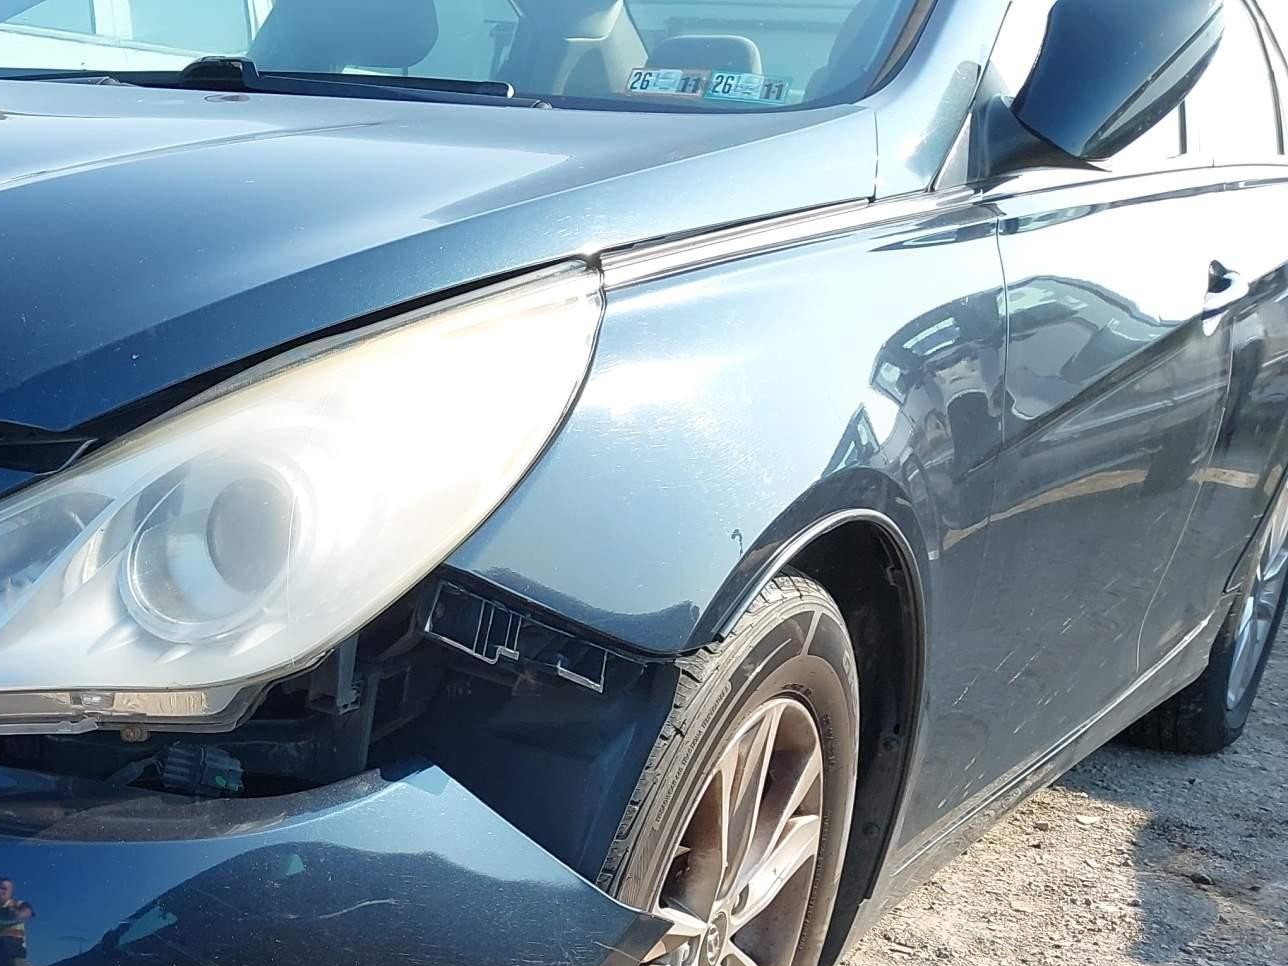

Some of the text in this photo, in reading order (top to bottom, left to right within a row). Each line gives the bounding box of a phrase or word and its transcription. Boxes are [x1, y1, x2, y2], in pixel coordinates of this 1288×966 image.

[630, 71, 652, 90] 26
[679, 76, 700, 93] 11
[712, 74, 734, 94] 26
[764, 83, 784, 101] 11
